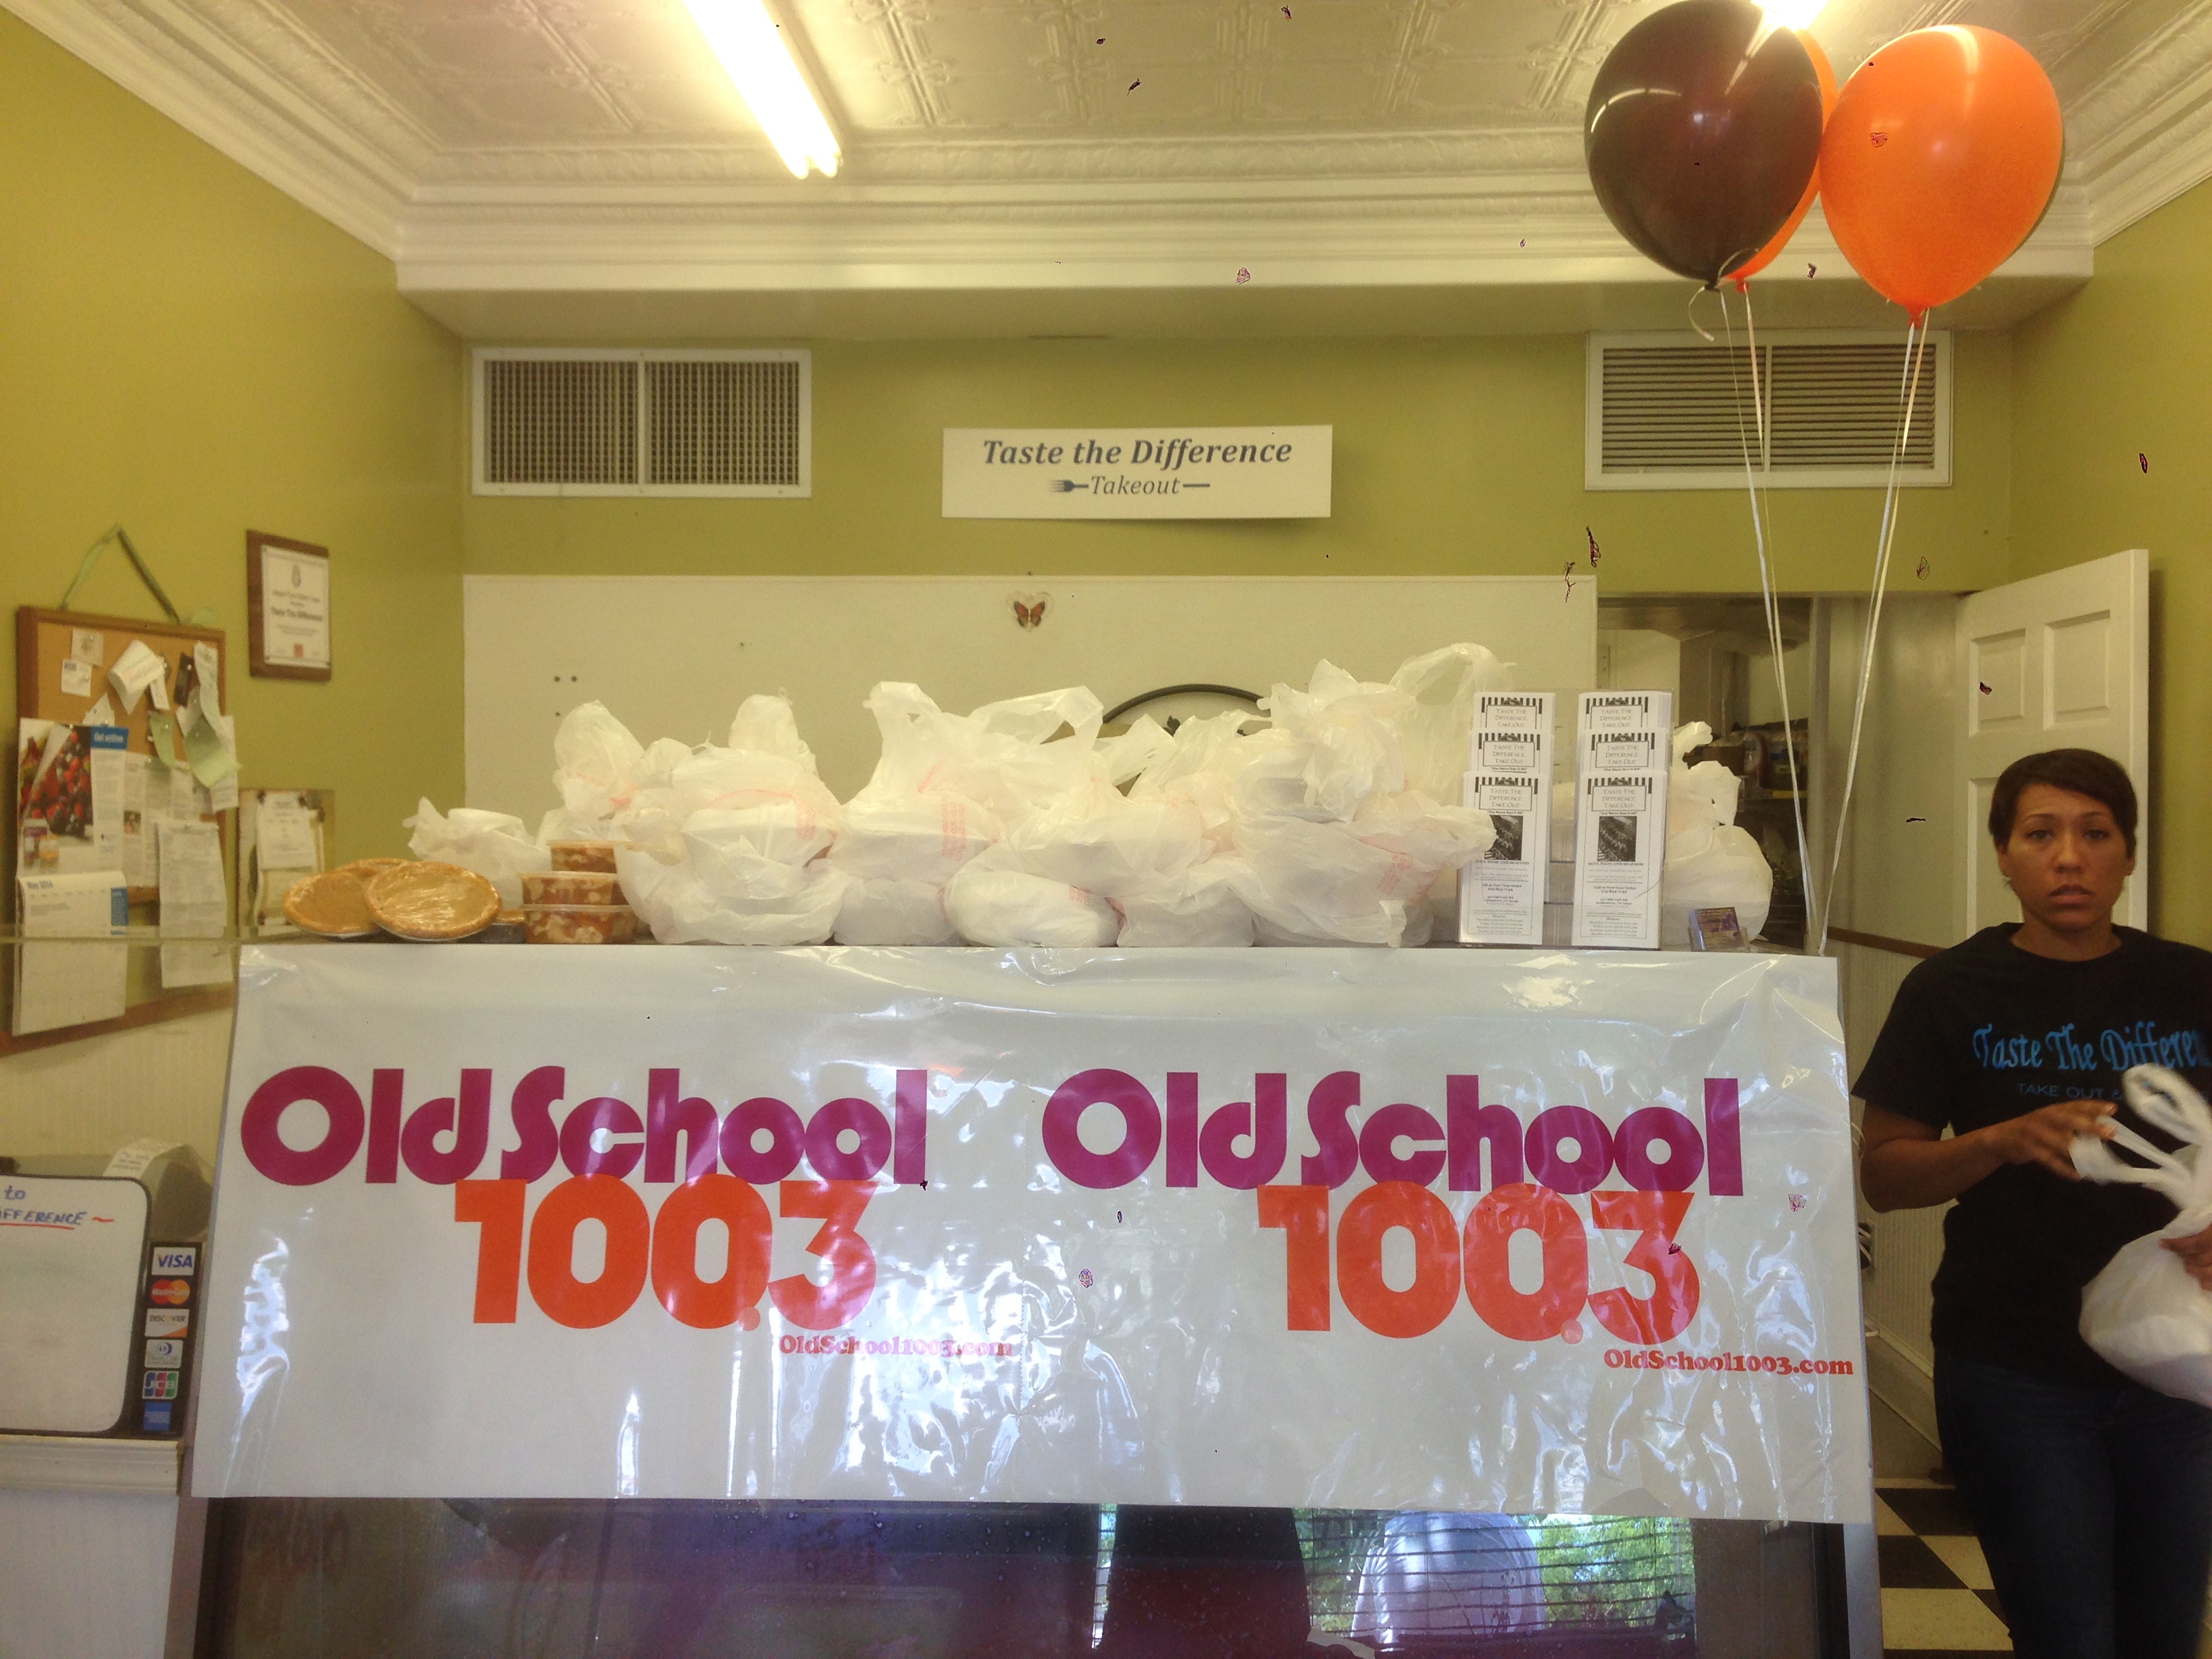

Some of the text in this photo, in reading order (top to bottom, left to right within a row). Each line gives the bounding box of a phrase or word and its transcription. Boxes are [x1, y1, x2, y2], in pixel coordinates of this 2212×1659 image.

[983, 438, 1293, 471] Taste the Difference
[1090, 475, 1182, 495] Takeout
[1973, 1023, 2044, 1069] Taste
[2045, 1022, 2098, 1071] The
[2018, 1083, 2060, 1098] TAKE
[2066, 1086, 2105, 1100] OUT
[4, 1185, 27, 1201] to
[158, 1254, 193, 1269] VISA
[455, 1173, 877, 1332] 100.3
[1257, 1181, 1700, 1345] 100.3
[779, 1334, 1012, 1358] OldSchool1003.com
[1603, 1348, 1854, 1376] OldSchool1003.com
[144, 1380, 175, 1389] JCB
